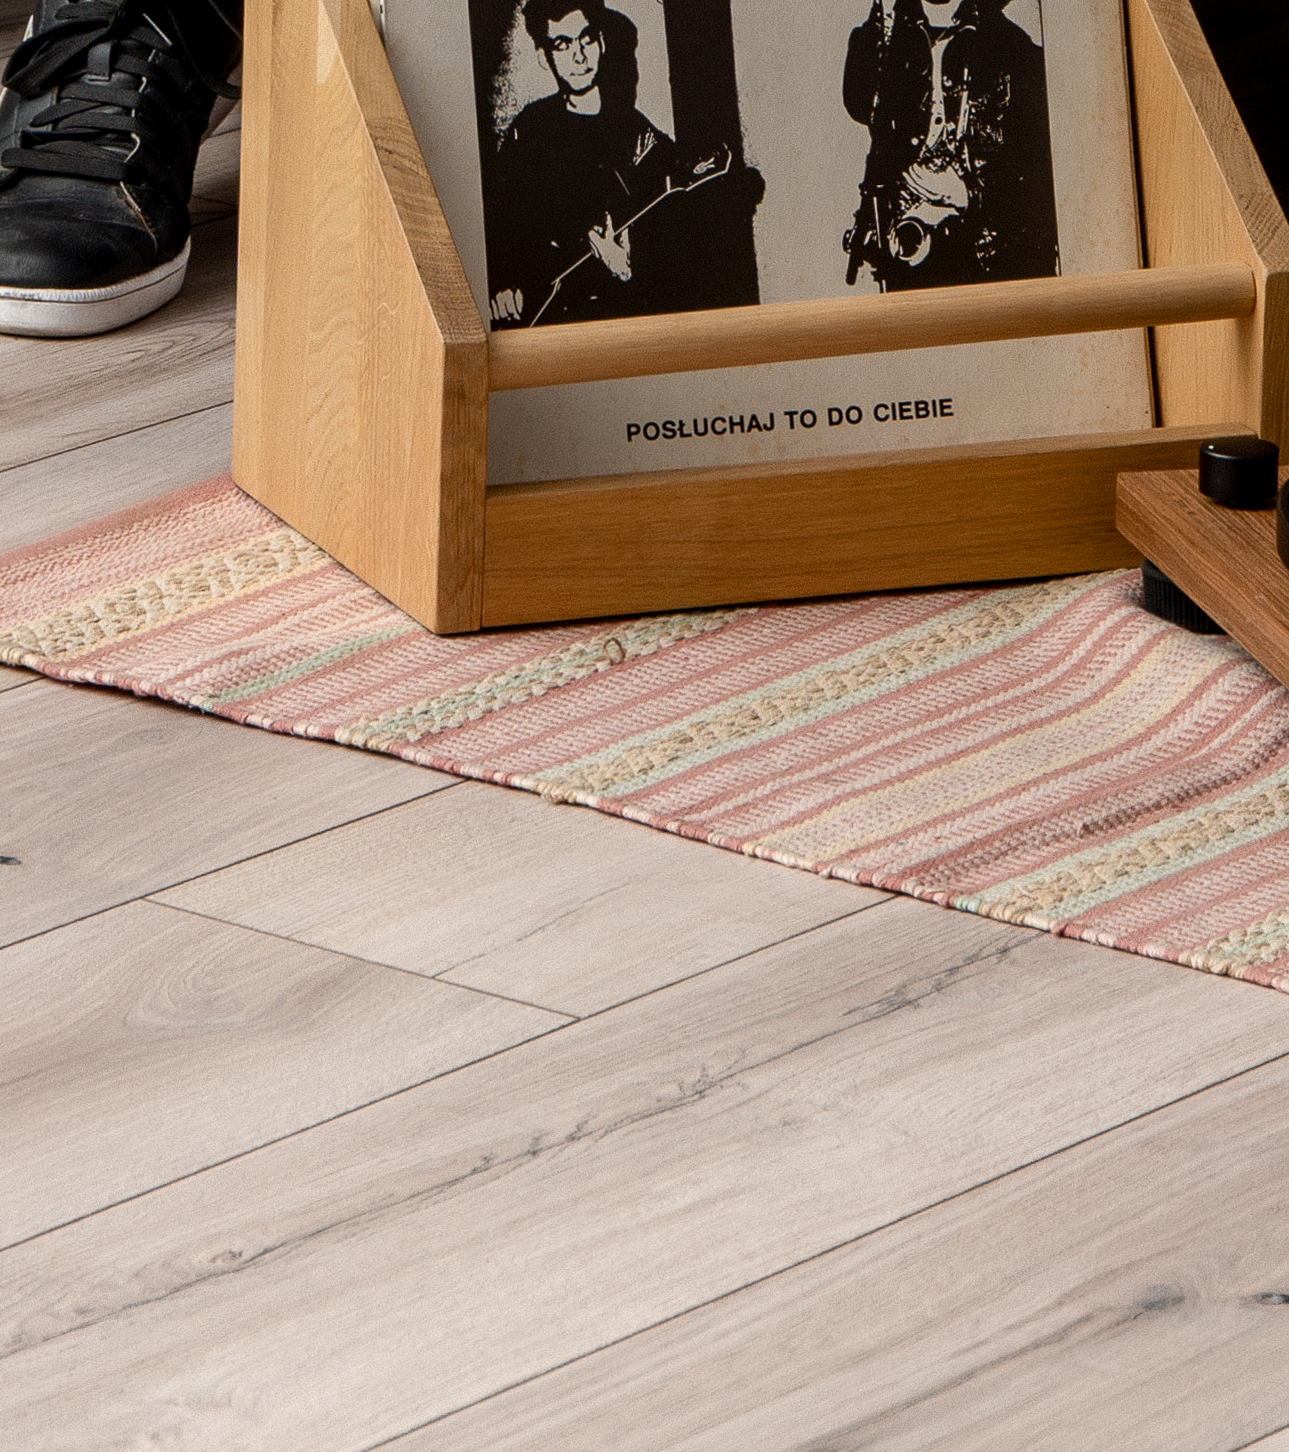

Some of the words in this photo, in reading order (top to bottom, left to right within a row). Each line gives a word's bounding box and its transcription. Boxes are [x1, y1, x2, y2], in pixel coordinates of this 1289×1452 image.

[626, 412, 775, 443] POSŁUCHAJ
[783, 409, 818, 432] TO
[827, 405, 863, 428] DO
[873, 398, 954, 424] CIEBIE
